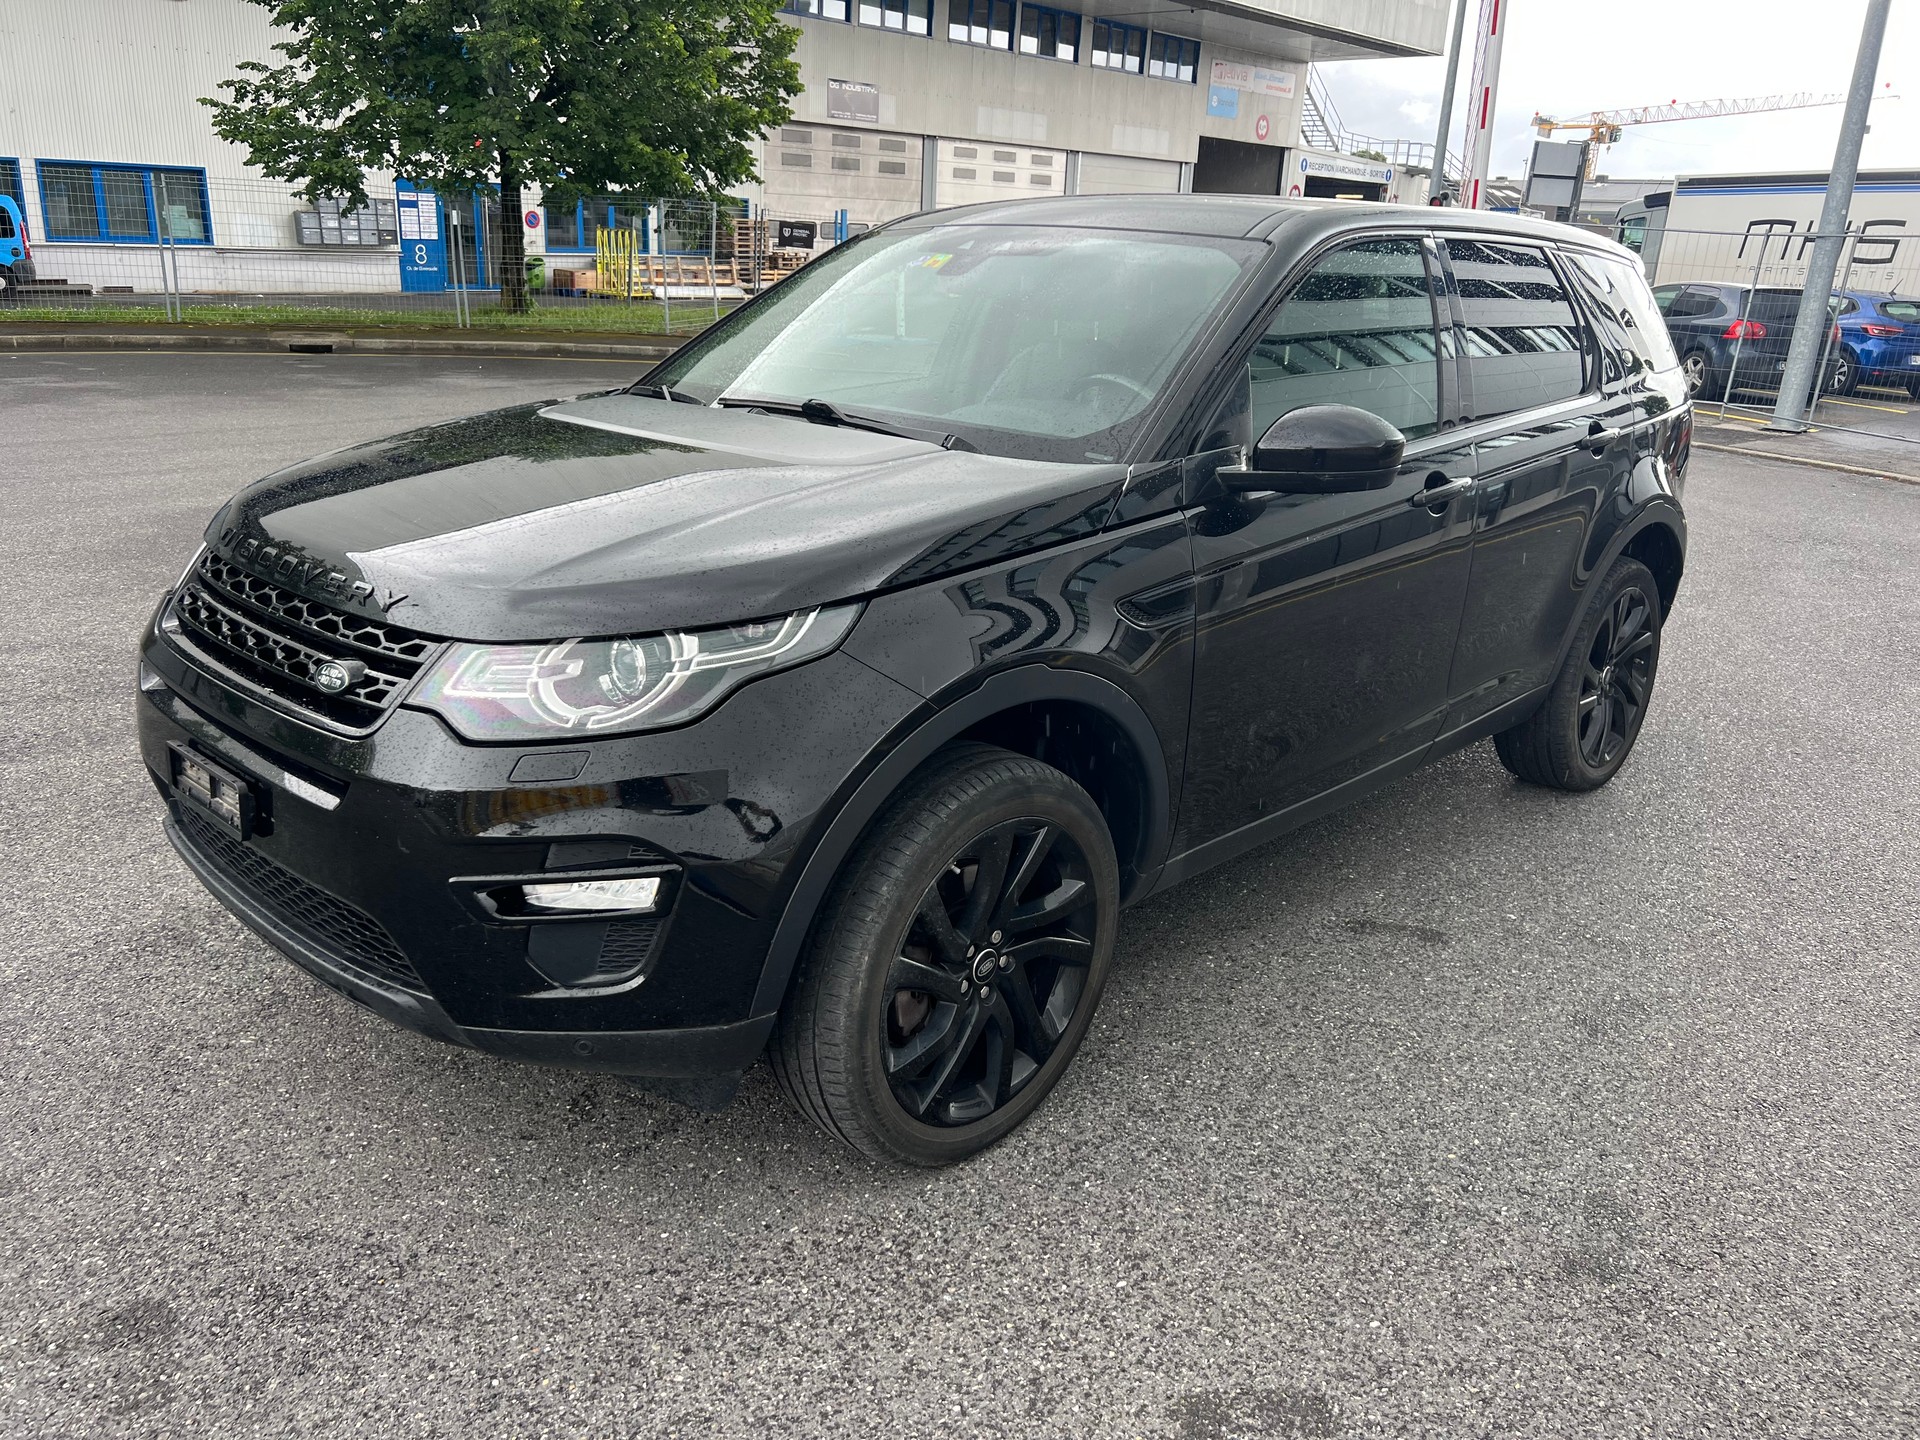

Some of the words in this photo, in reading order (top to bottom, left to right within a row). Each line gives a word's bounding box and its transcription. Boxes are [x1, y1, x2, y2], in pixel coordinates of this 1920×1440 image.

[1308, 161, 1335, 173] RECEPTION
[415, 244, 427, 264] 8
[221, 527, 409, 614] DISCOVERY
[321, 665, 340, 678] LAND
[320, 674, 342, 688] ROVER
